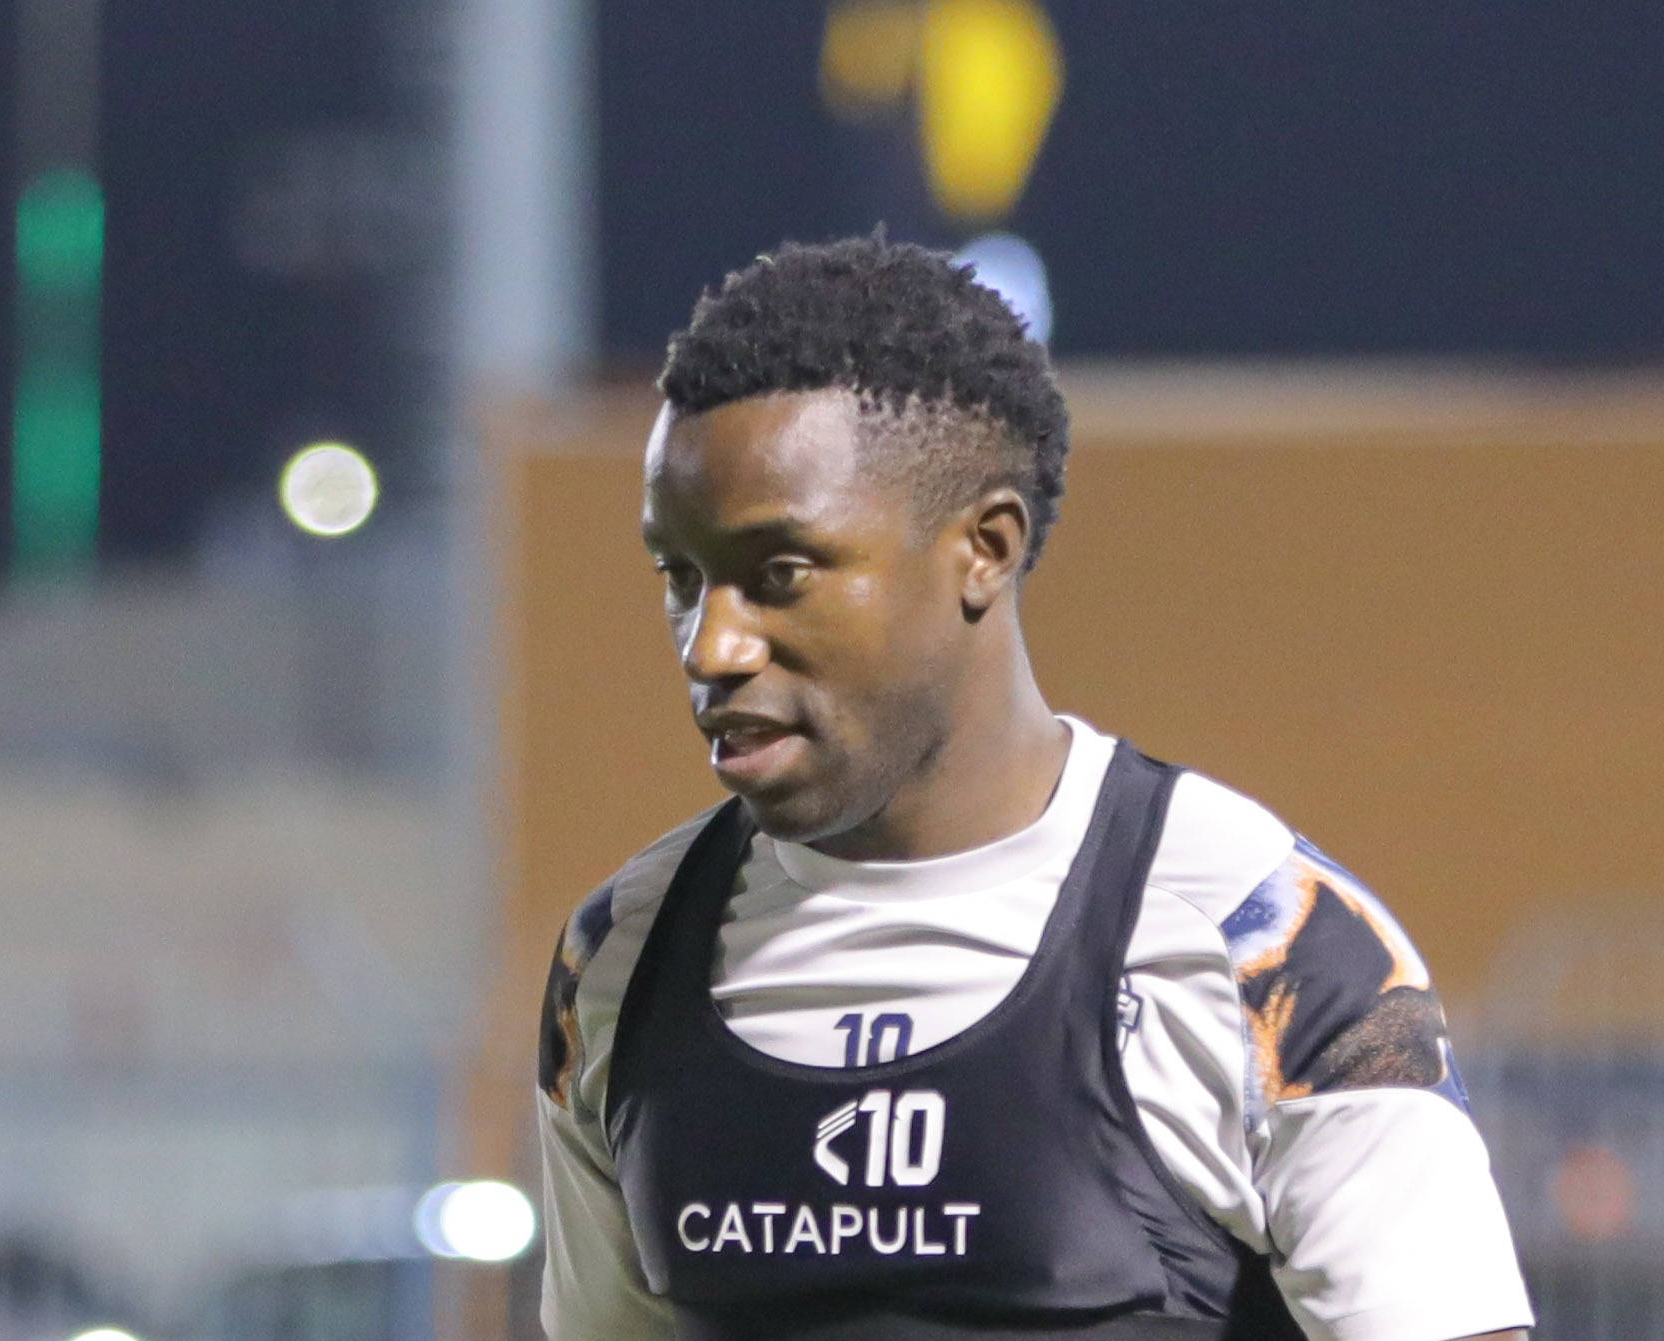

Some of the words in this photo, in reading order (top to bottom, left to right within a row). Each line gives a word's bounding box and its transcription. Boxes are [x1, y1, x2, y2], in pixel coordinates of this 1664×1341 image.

[834, 1013, 914, 1068] 10
[858, 1089, 946, 1187] 10
[677, 1202, 981, 1256] CATAPULT
